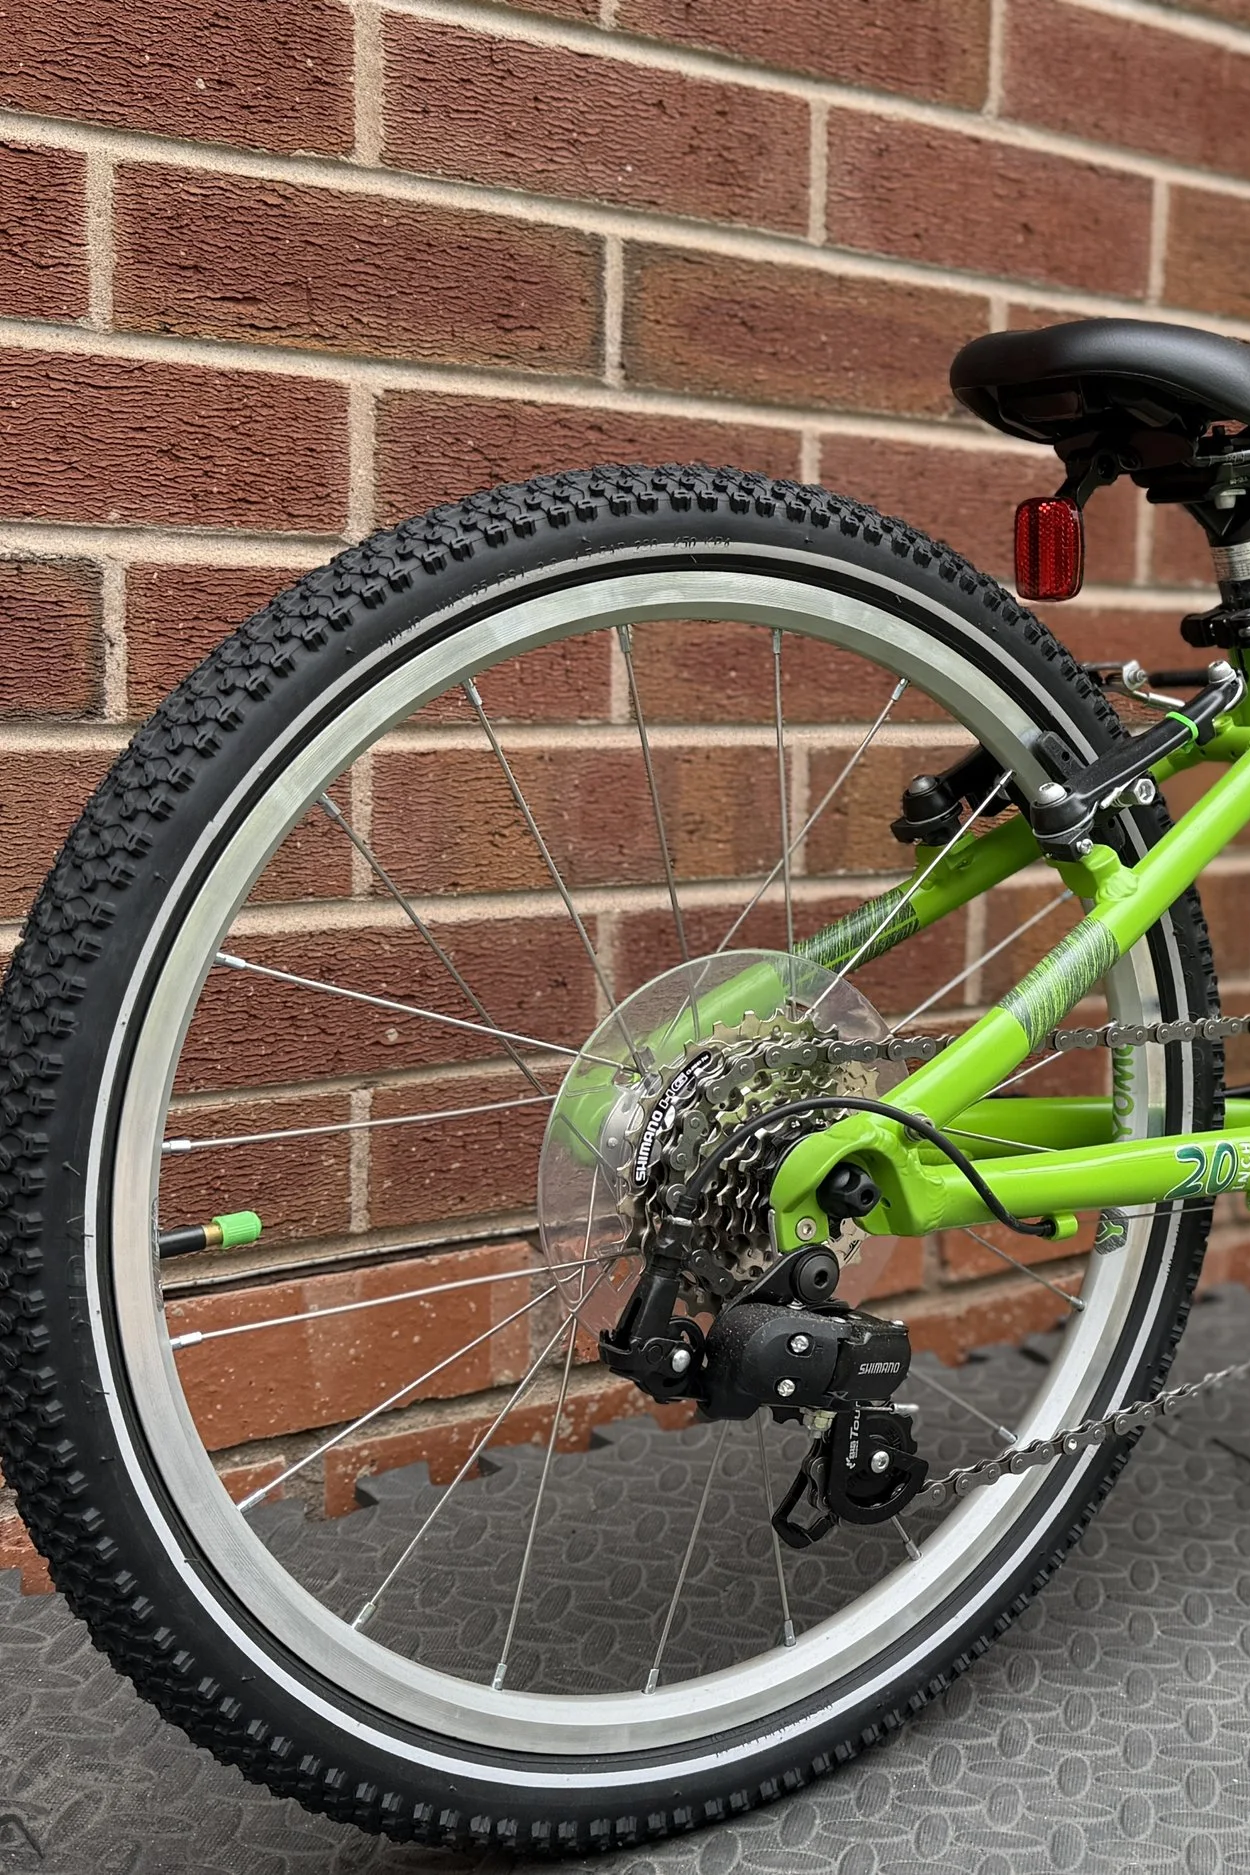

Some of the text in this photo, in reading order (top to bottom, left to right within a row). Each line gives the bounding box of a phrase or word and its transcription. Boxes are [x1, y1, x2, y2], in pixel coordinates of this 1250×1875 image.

[635, 1110, 663, 1181] SHIMANO
[1163, 1140, 1239, 1200] 20
[858, 1362, 900, 1375] SHIMANO
